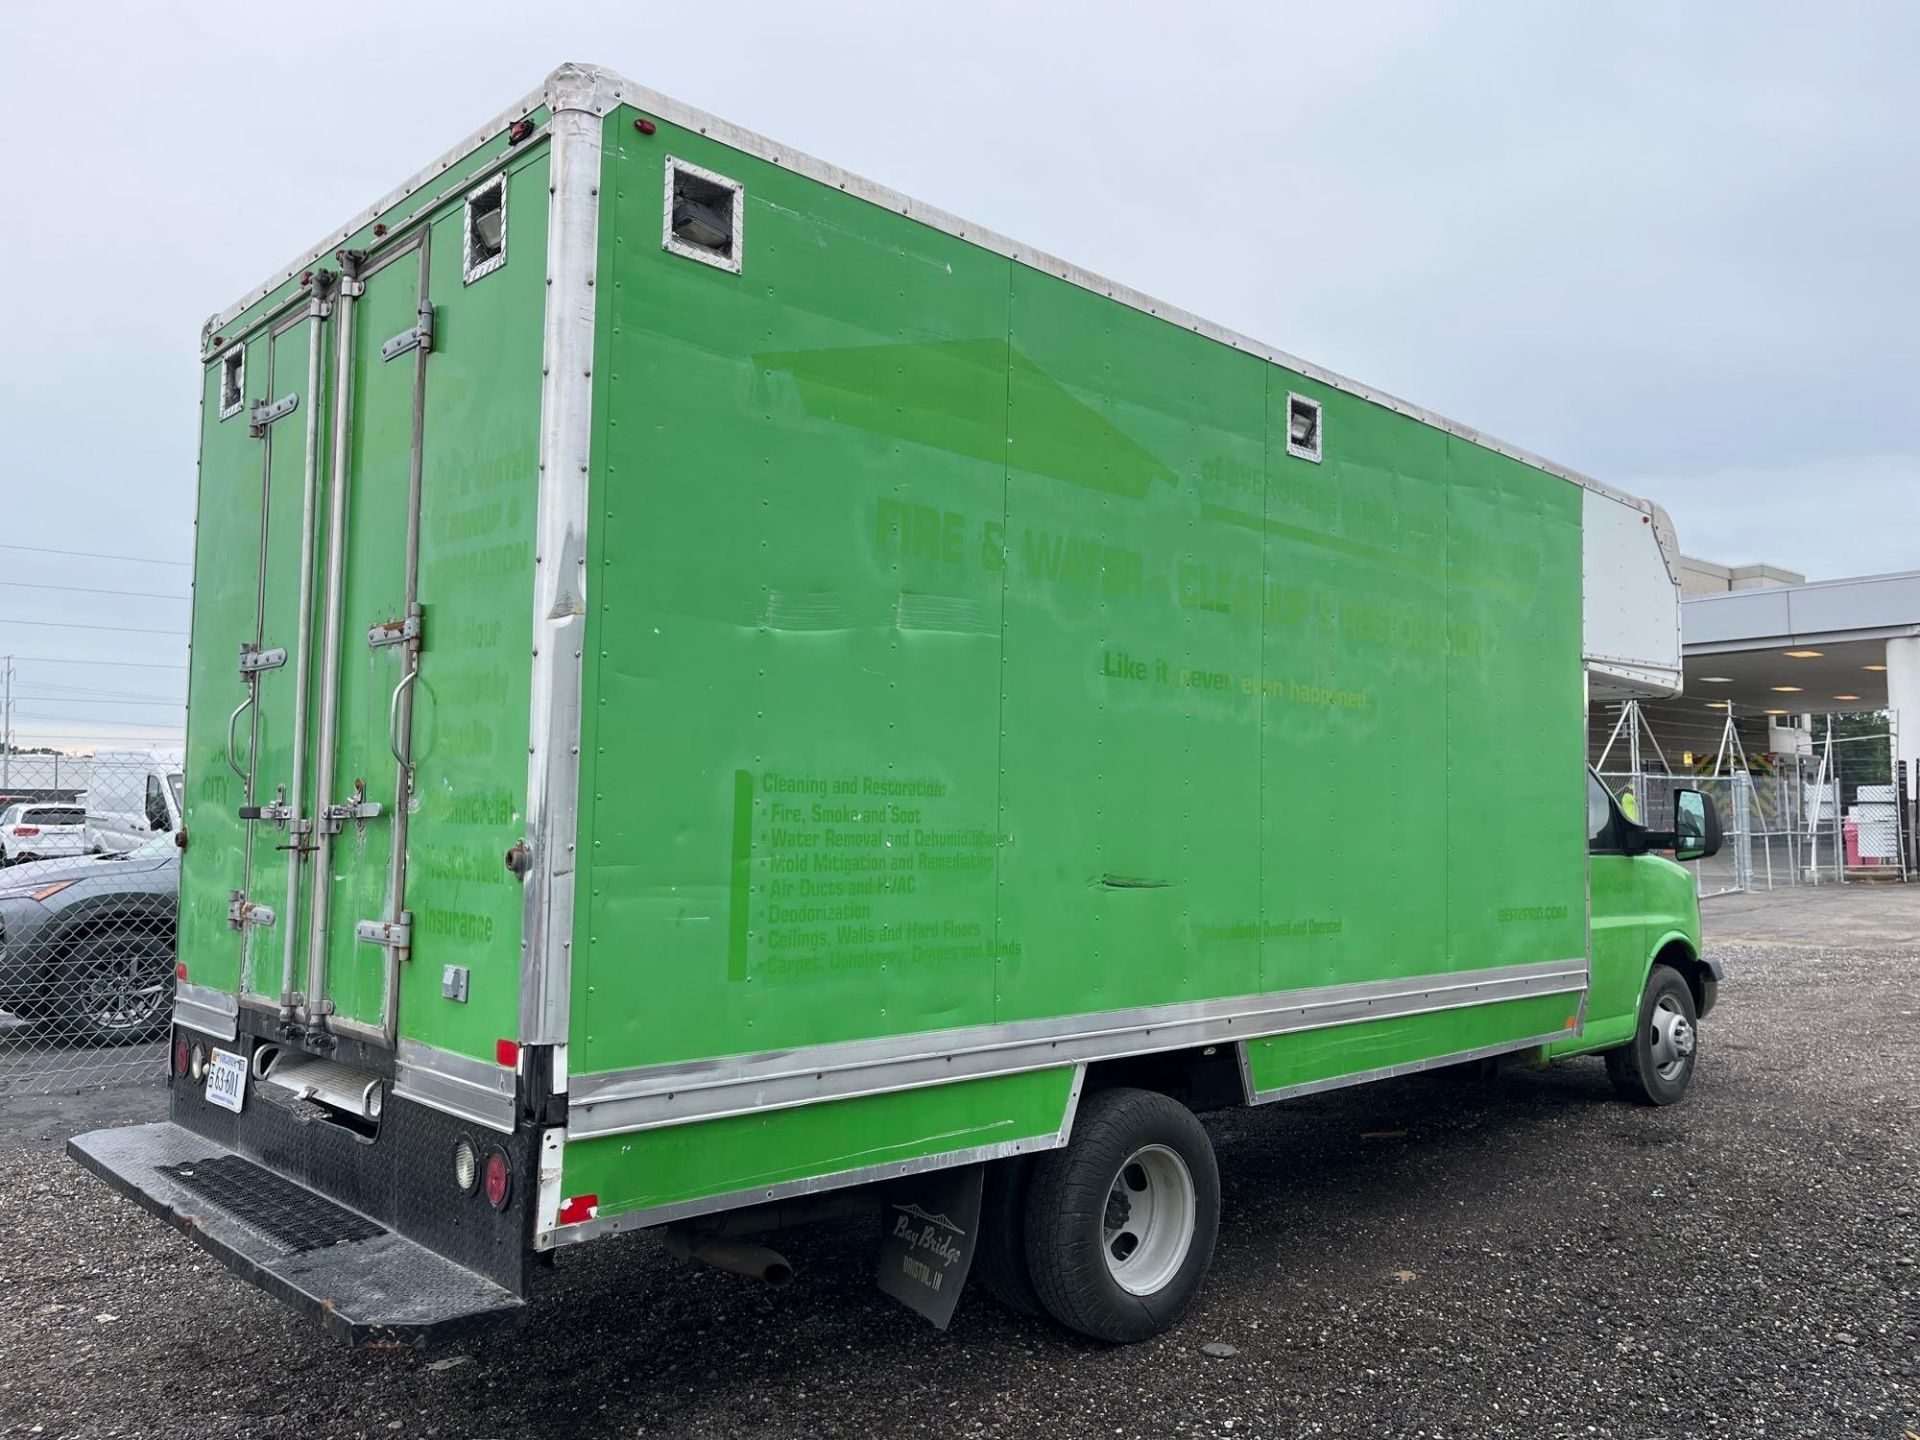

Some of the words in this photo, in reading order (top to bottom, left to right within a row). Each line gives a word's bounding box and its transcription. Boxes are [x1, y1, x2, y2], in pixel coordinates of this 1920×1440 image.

[876, 497, 966, 565] FIRE
[980, 520, 1007, 572] &
[1025, 527, 1143, 597] WATER
[1104, 650, 1147, 680] Like
[1156, 658, 1170, 683] it
[1180, 667, 1232, 690] never
[1240, 676, 1282, 698] even
[762, 772, 828, 799] Cleaning
[832, 776, 858, 795] and
[770, 803, 806, 825] Fire,
[811, 804, 860, 824] Smoke
[863, 805, 886, 823] and
[890, 805, 922, 824] Soot
[770, 828, 820, 848] Water
[825, 828, 882, 848] Removal
[886, 829, 910, 848] and
[770, 854, 808, 874] Mold
[813, 853, 886, 876] Mitigation
[890, 853, 914, 872] and
[769, 878, 794, 899] Air
[799, 878, 844, 898] Ducts
[848, 877, 874, 896] and
[424, 899, 493, 943] Insurance
[768, 903, 870, 925] Deodorization
[837, 925, 875, 945] Walls
[879, 923, 902, 942] and
[906, 922, 939, 941] Hard
[943, 920, 981, 938] Floors
[892, 1215, 920, 1250] Bay
[917, 1225, 961, 1267] Bridge
[932, 1270, 944, 1292] IN
